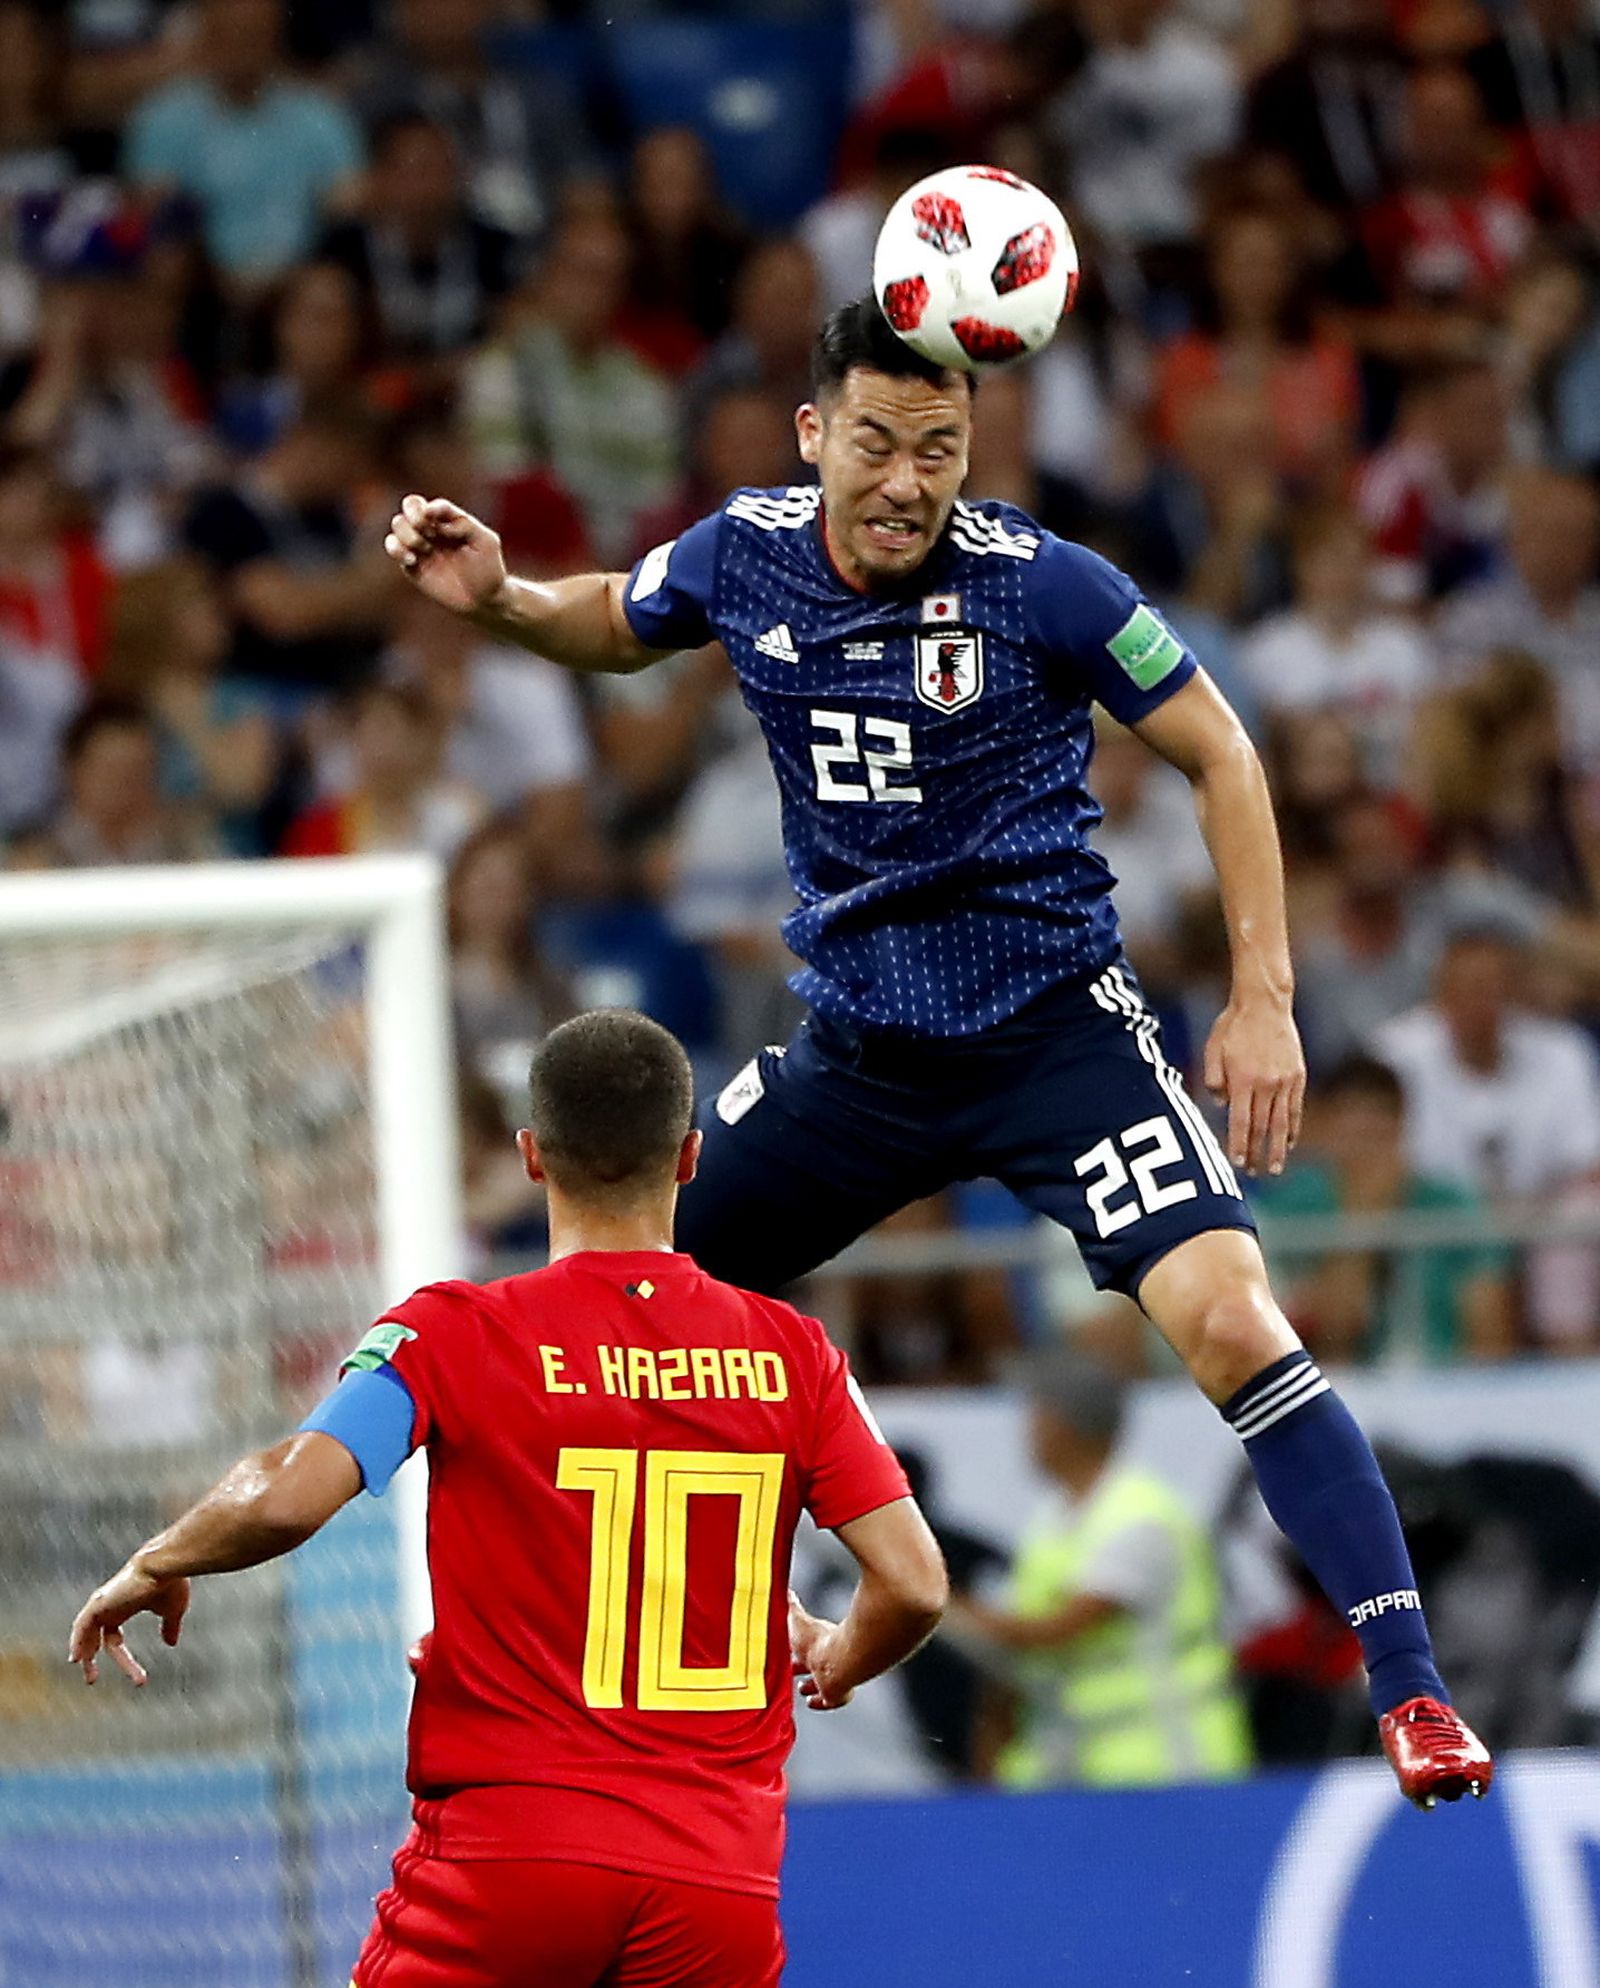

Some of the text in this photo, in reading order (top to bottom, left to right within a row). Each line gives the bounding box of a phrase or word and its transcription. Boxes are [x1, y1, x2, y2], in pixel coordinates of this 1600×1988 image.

[809, 710, 923, 803] 22
[1073, 1115, 1198, 1239] 22
[538, 1344, 790, 1402] E. HAZARD
[555, 1447, 786, 1711] 10
[1347, 1589, 1422, 1627] JAPAN
